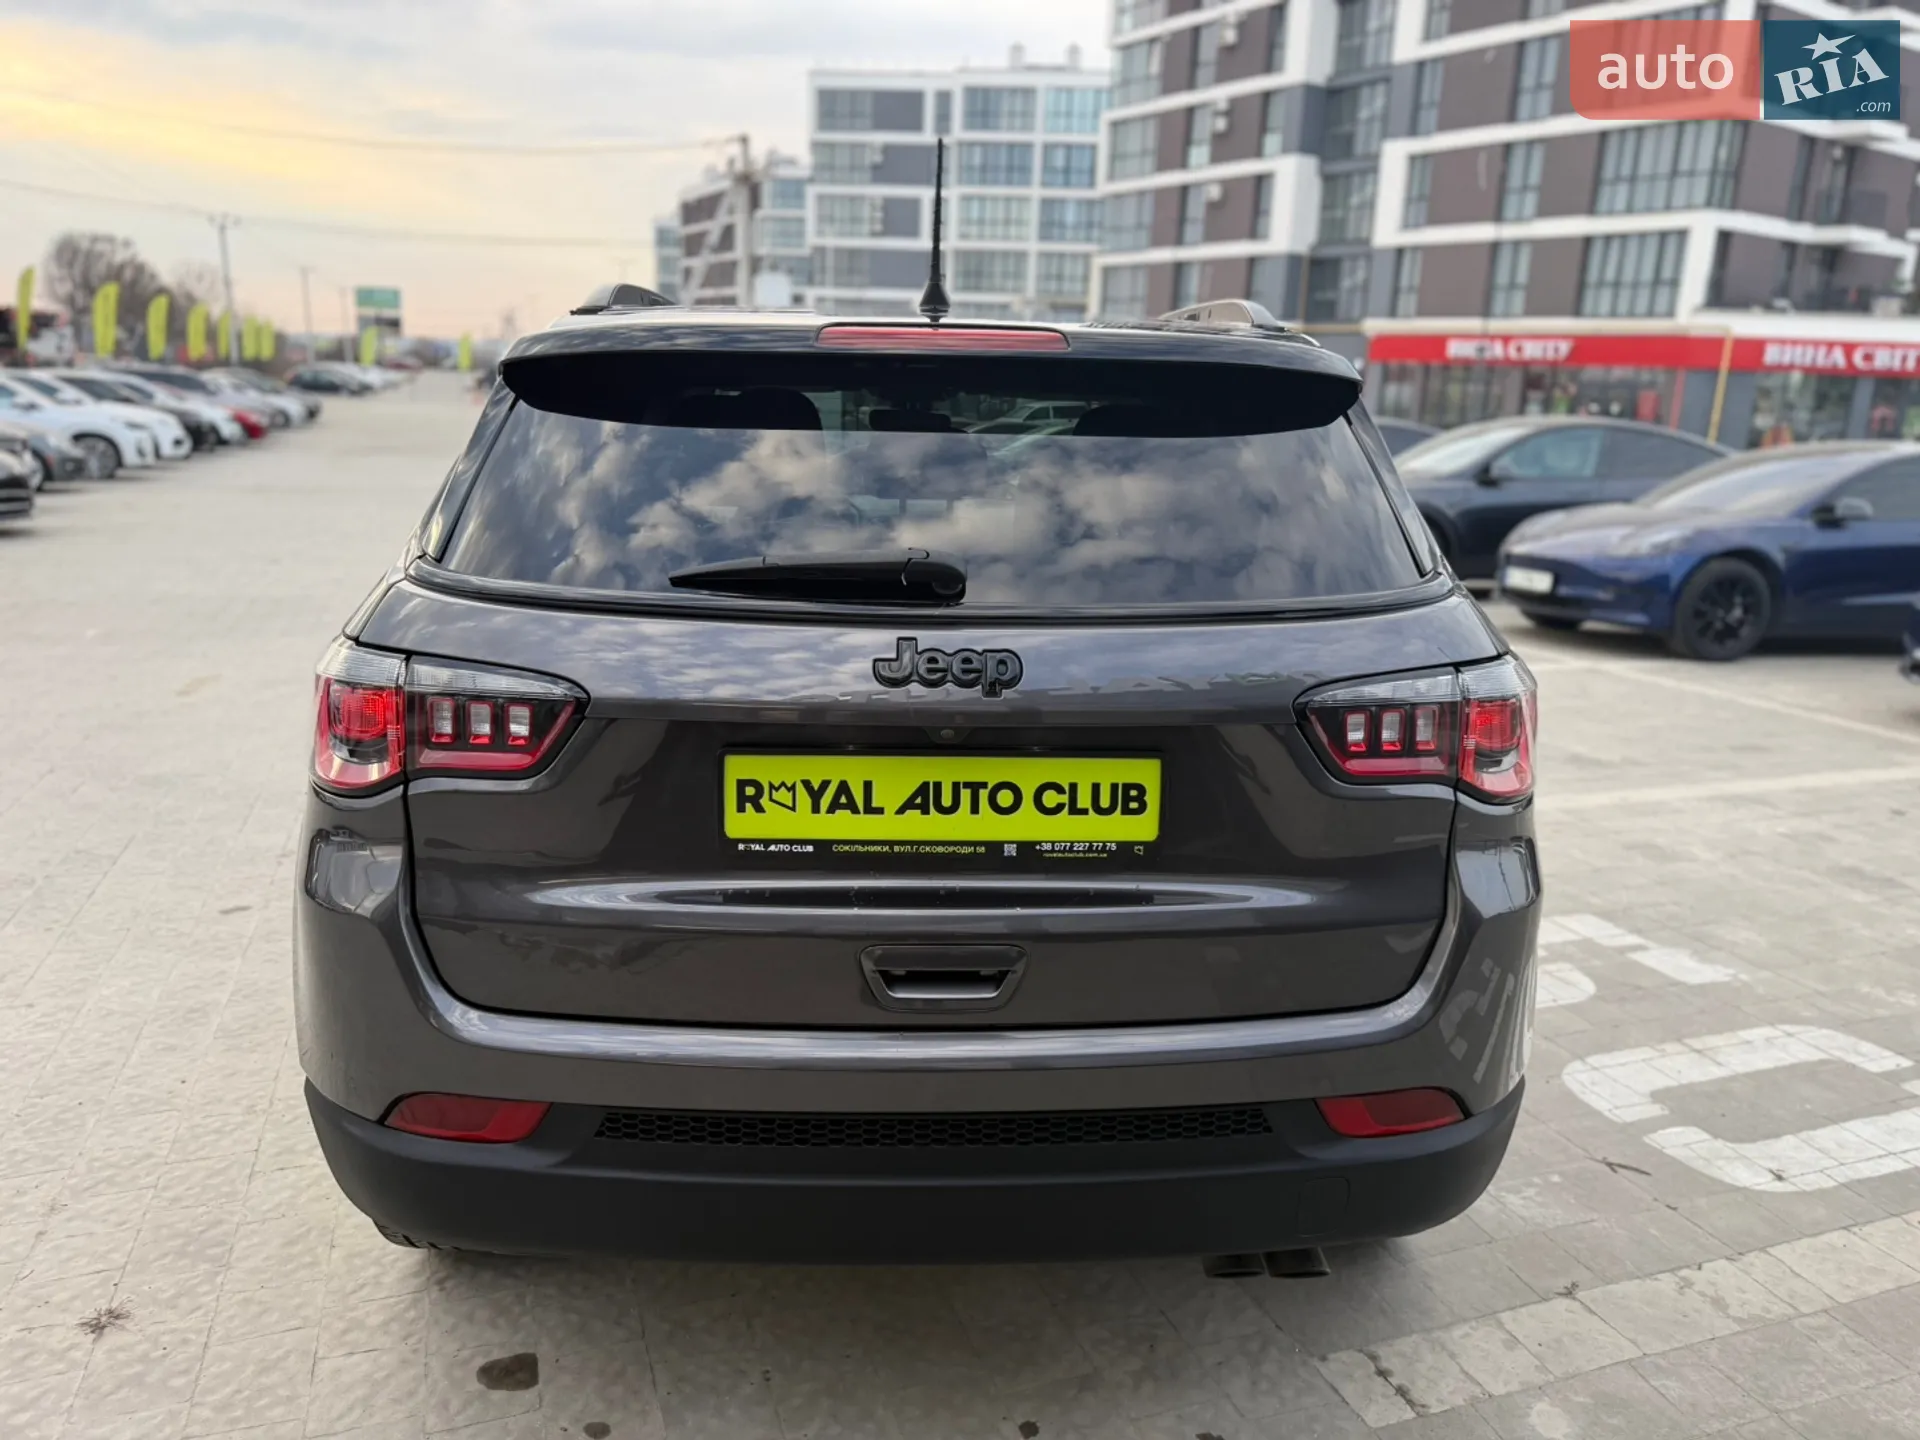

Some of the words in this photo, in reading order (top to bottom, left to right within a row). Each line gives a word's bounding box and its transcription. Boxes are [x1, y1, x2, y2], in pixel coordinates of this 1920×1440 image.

[872, 636, 1024, 698] Jeep
[894, 780, 1023, 817] AUTO
[1031, 781, 1148, 817] CLUB
[767, 844, 790, 852] AUTO
